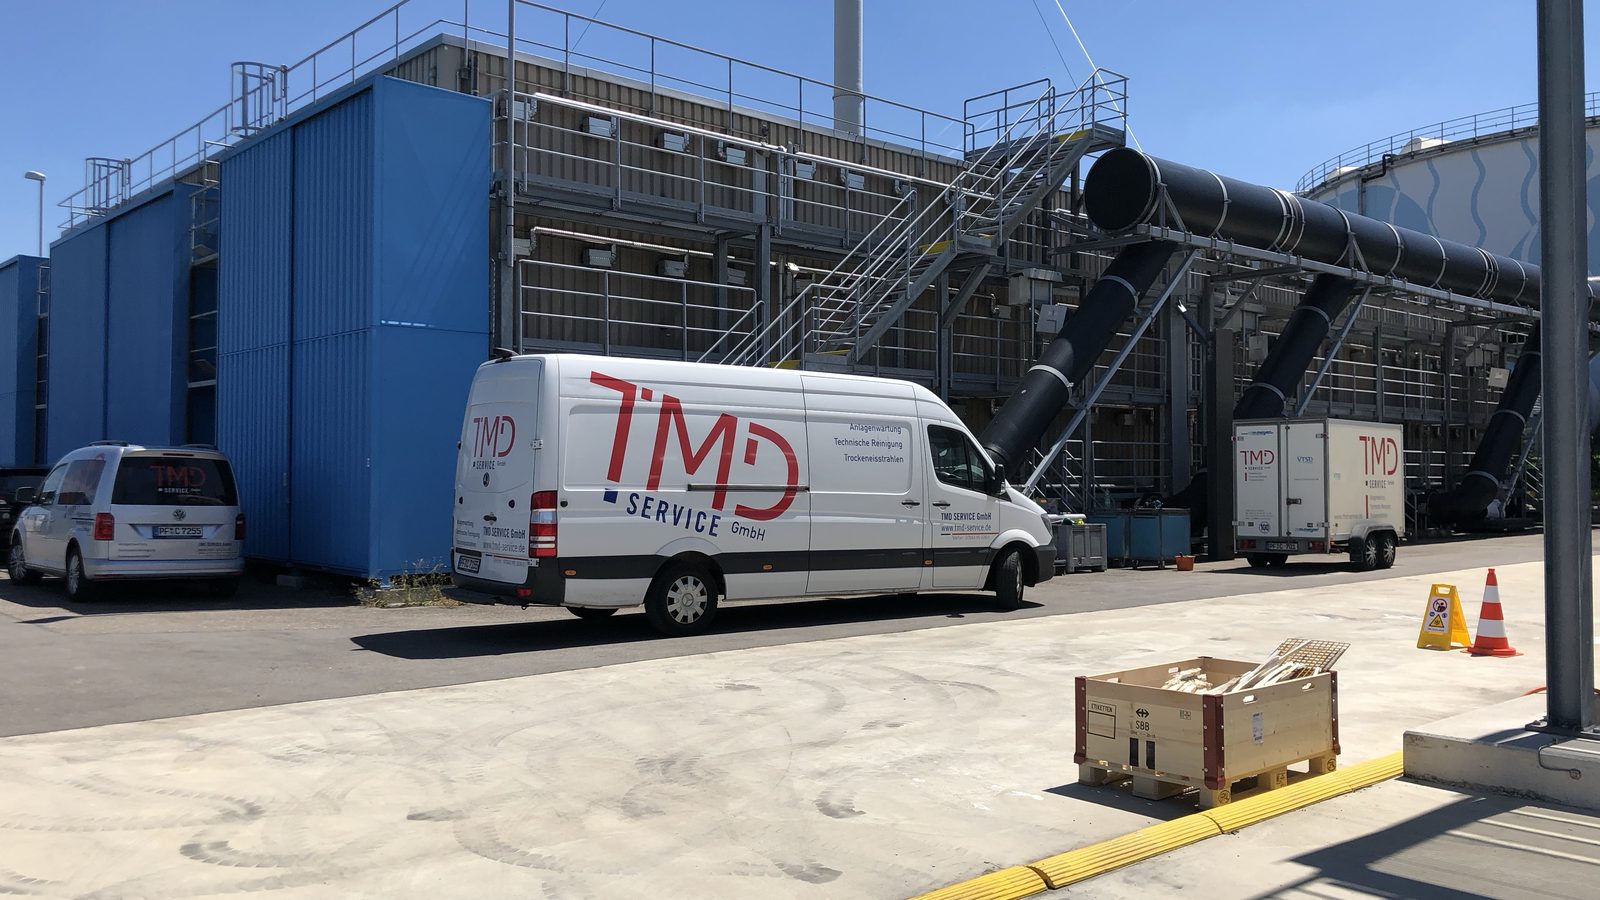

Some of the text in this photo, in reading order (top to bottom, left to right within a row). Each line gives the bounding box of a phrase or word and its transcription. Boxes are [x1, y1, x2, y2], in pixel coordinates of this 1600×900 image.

[850, 423, 902, 434] Anlagenwartung
[473, 416, 515, 457] TMD
[590, 371, 799, 521] TMD
[834, 438, 903, 449] Technische Reinigung
[844, 453, 904, 463] Trockeneisstrahlen
[1240, 450, 1275, 465] TMD
[1359, 435, 1398, 475] TMD
[150, 465, 206, 487] TMD
[626, 492, 766, 541] SERVICE GmbH
[941, 512, 992, 520] TMD SERVICE GmbH
[941, 523, 991, 531] www.tmd-service.de
[492, 527, 510, 538] SERVICE
[511, 529, 526, 539] GmbH
[1091, 703, 1113, 713] ETIKETTEN
[1135, 720, 1150, 731] SBB
